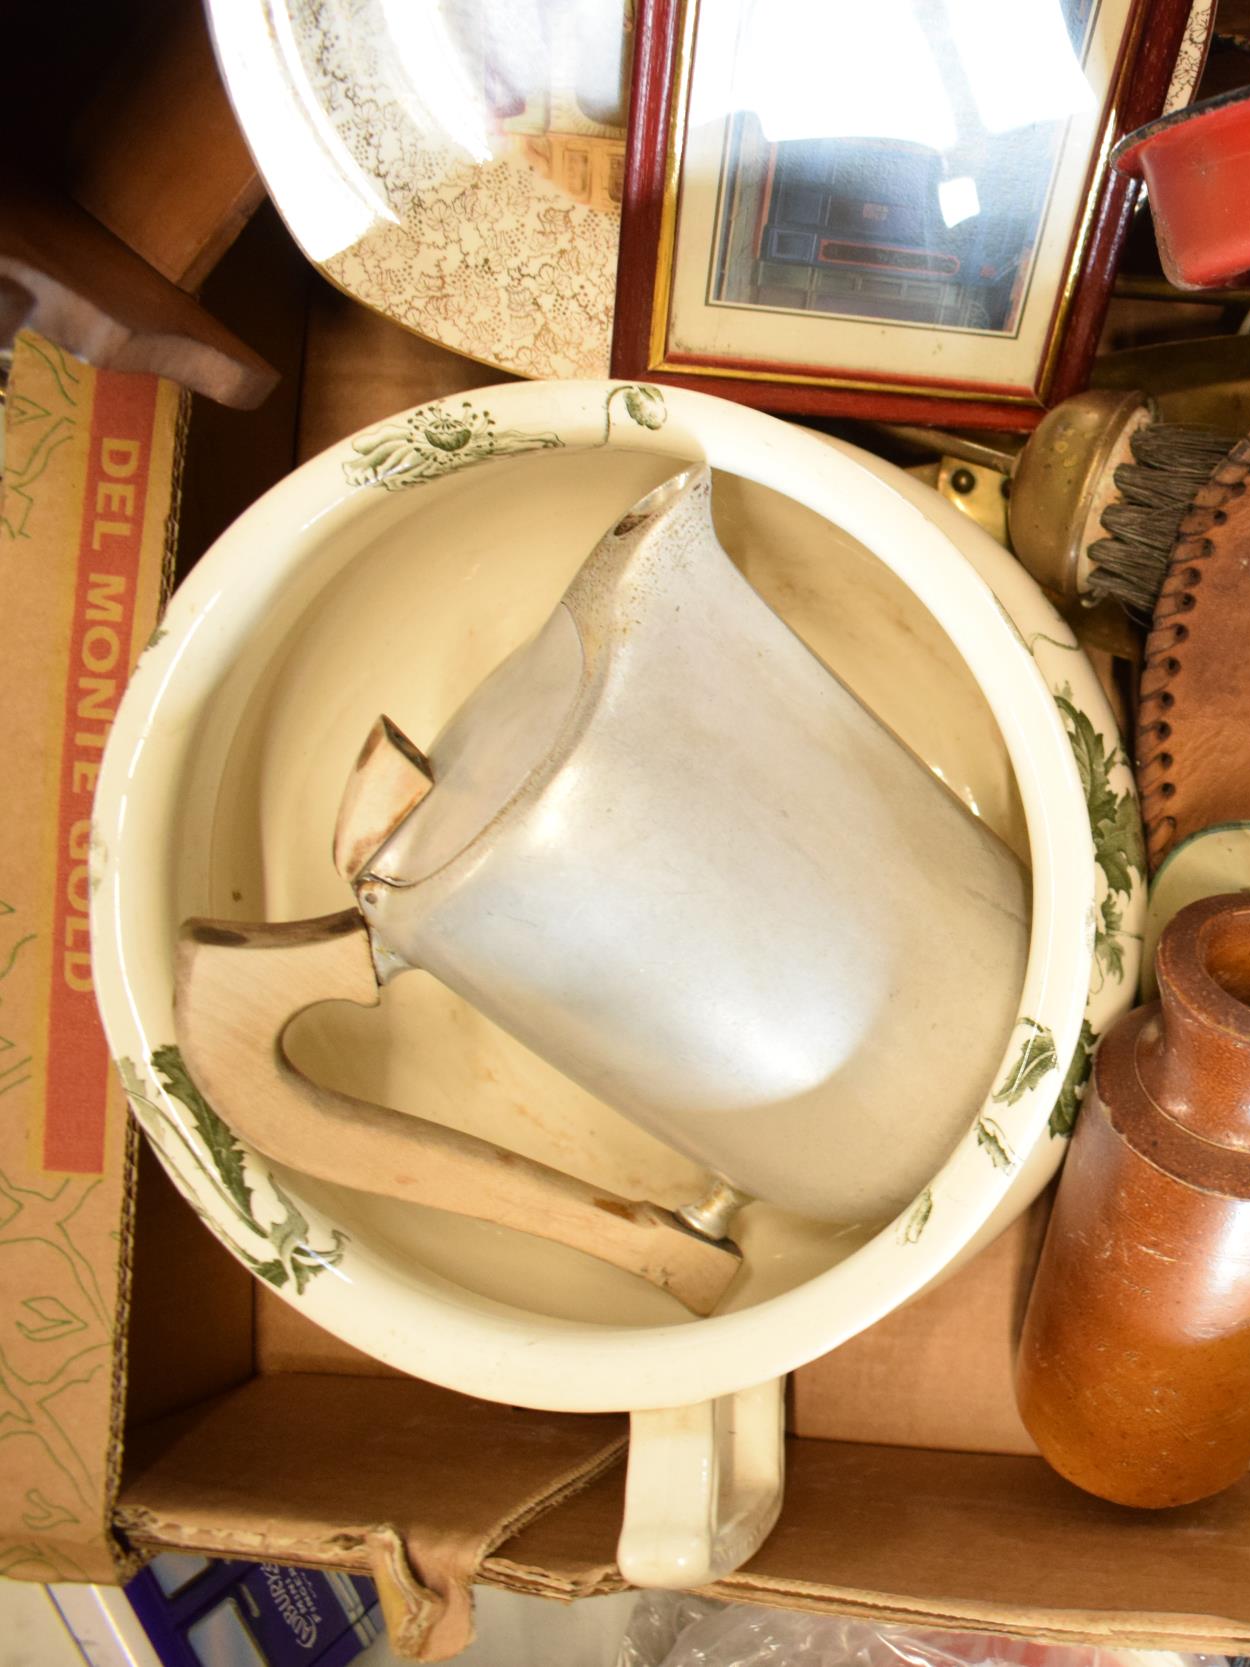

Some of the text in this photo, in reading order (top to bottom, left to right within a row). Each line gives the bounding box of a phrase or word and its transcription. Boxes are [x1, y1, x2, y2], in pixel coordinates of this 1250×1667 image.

[63, 437, 141, 993] DEL MONTE GOLD
[288, 1567, 322, 1624] FINGER
